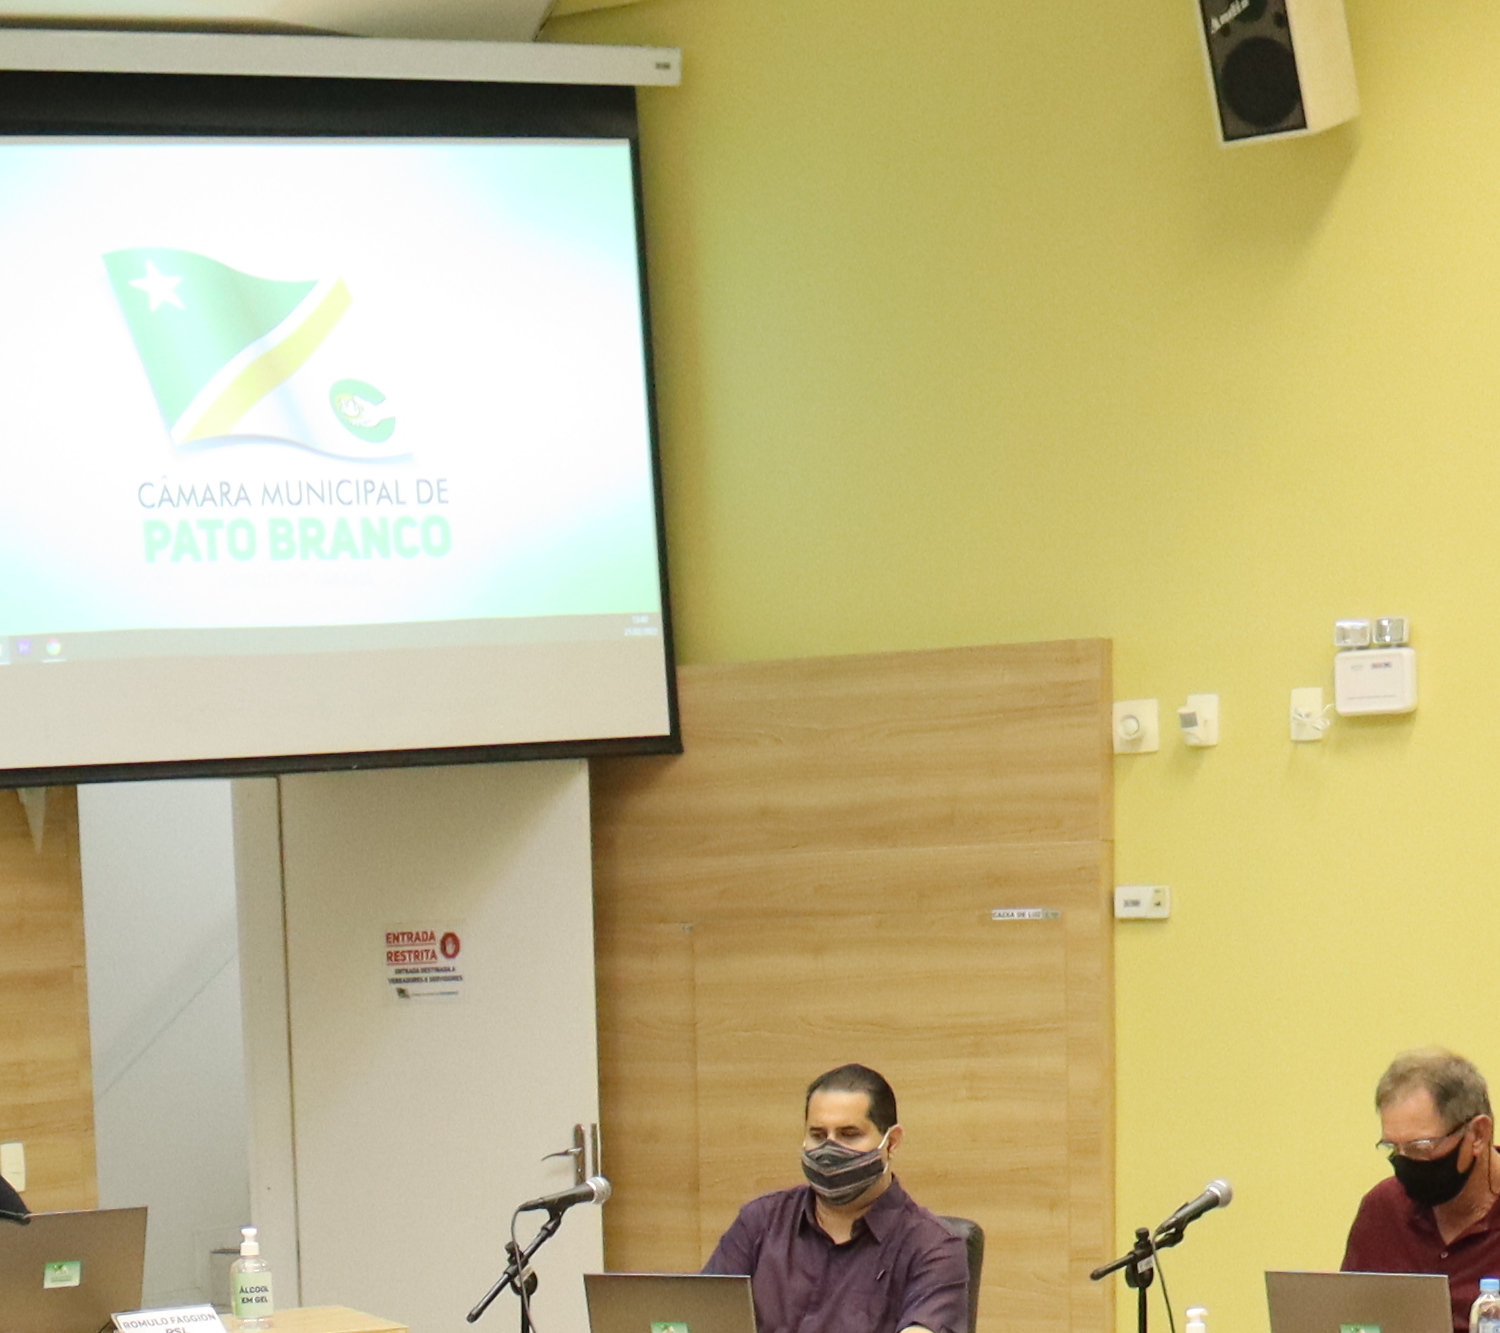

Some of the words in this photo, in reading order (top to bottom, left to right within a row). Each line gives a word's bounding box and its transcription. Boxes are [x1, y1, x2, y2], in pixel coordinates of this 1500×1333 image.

[138, 476, 252, 509] CÂMARA
[261, 479, 407, 507] MUNICIPAL
[416, 478, 450, 505] DE
[143, 517, 257, 563] PATO
[268, 514, 452, 561] BRANCO
[386, 931, 436, 943] ENTRADA
[386, 949, 437, 962] RESTRITA
[123, 1318, 168, 1329] ROMULO
[169, 1313, 217, 1325] FAGGION
